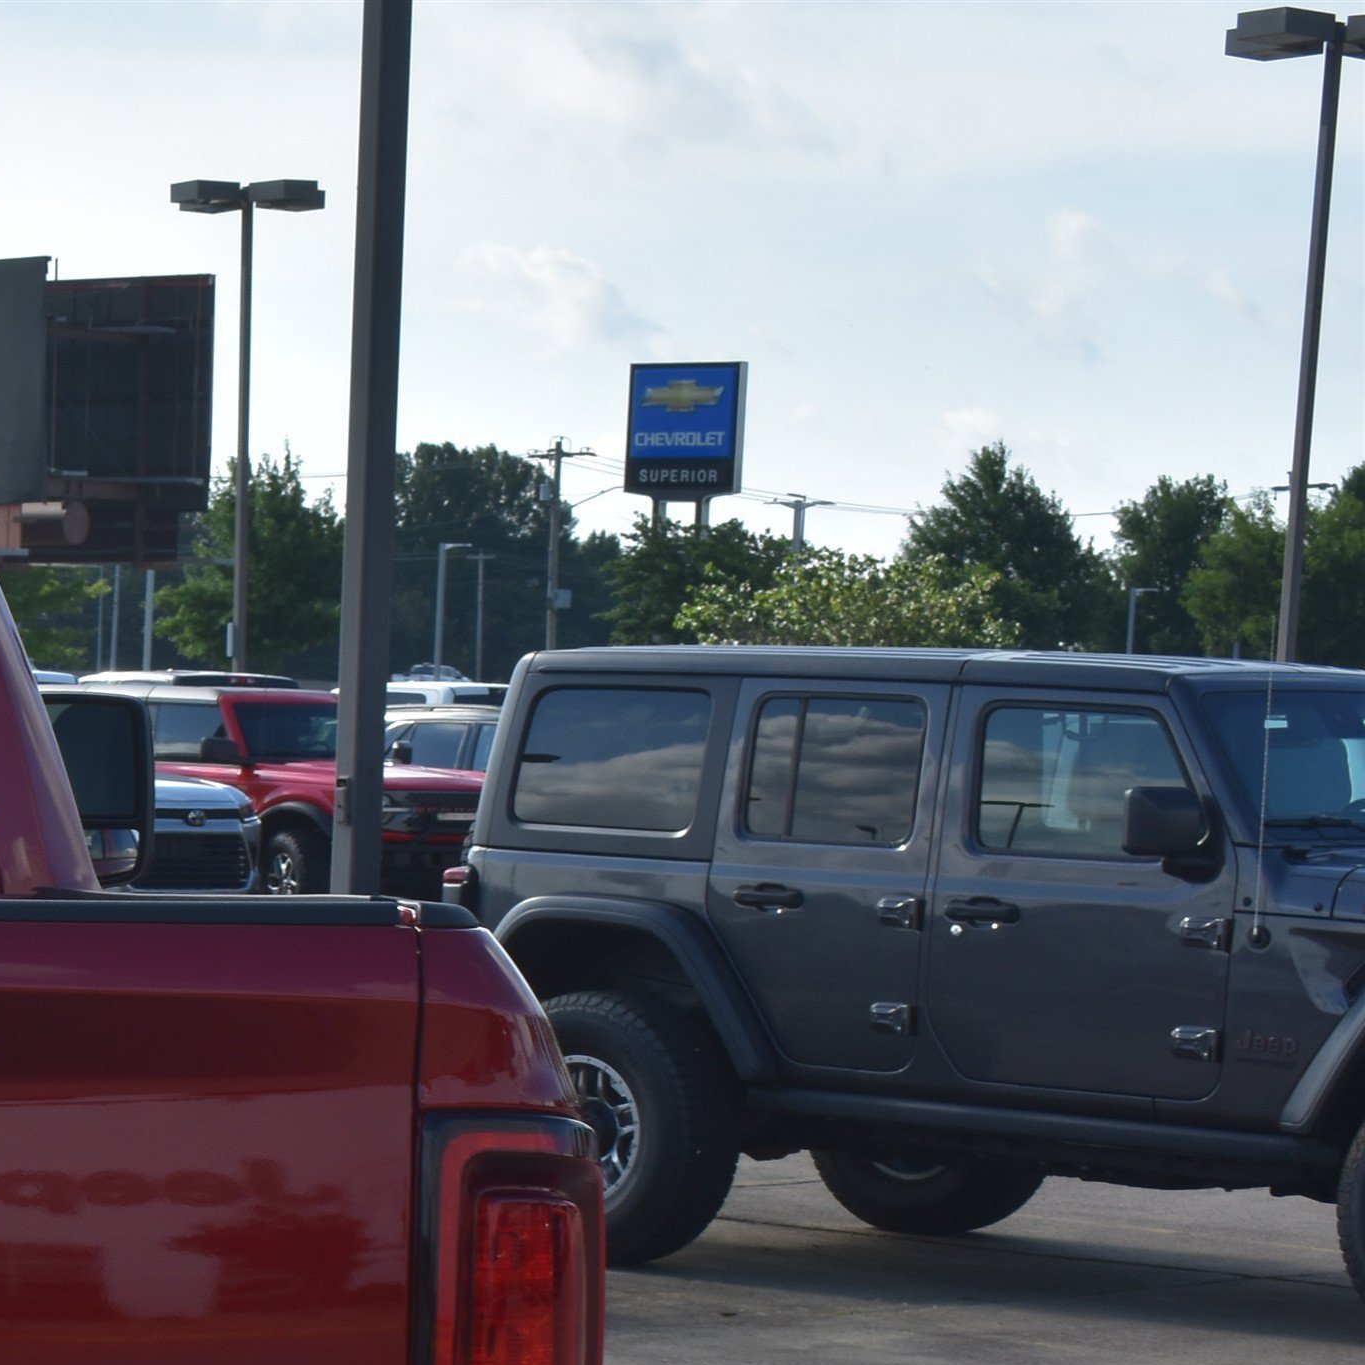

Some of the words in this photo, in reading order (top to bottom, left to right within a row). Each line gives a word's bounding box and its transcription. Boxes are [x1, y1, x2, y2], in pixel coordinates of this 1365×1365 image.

[634, 431, 725, 447] CHEVROLET
[638, 468, 718, 483] SUPERIOR
[1233, 1029, 1298, 1057] Jeep
